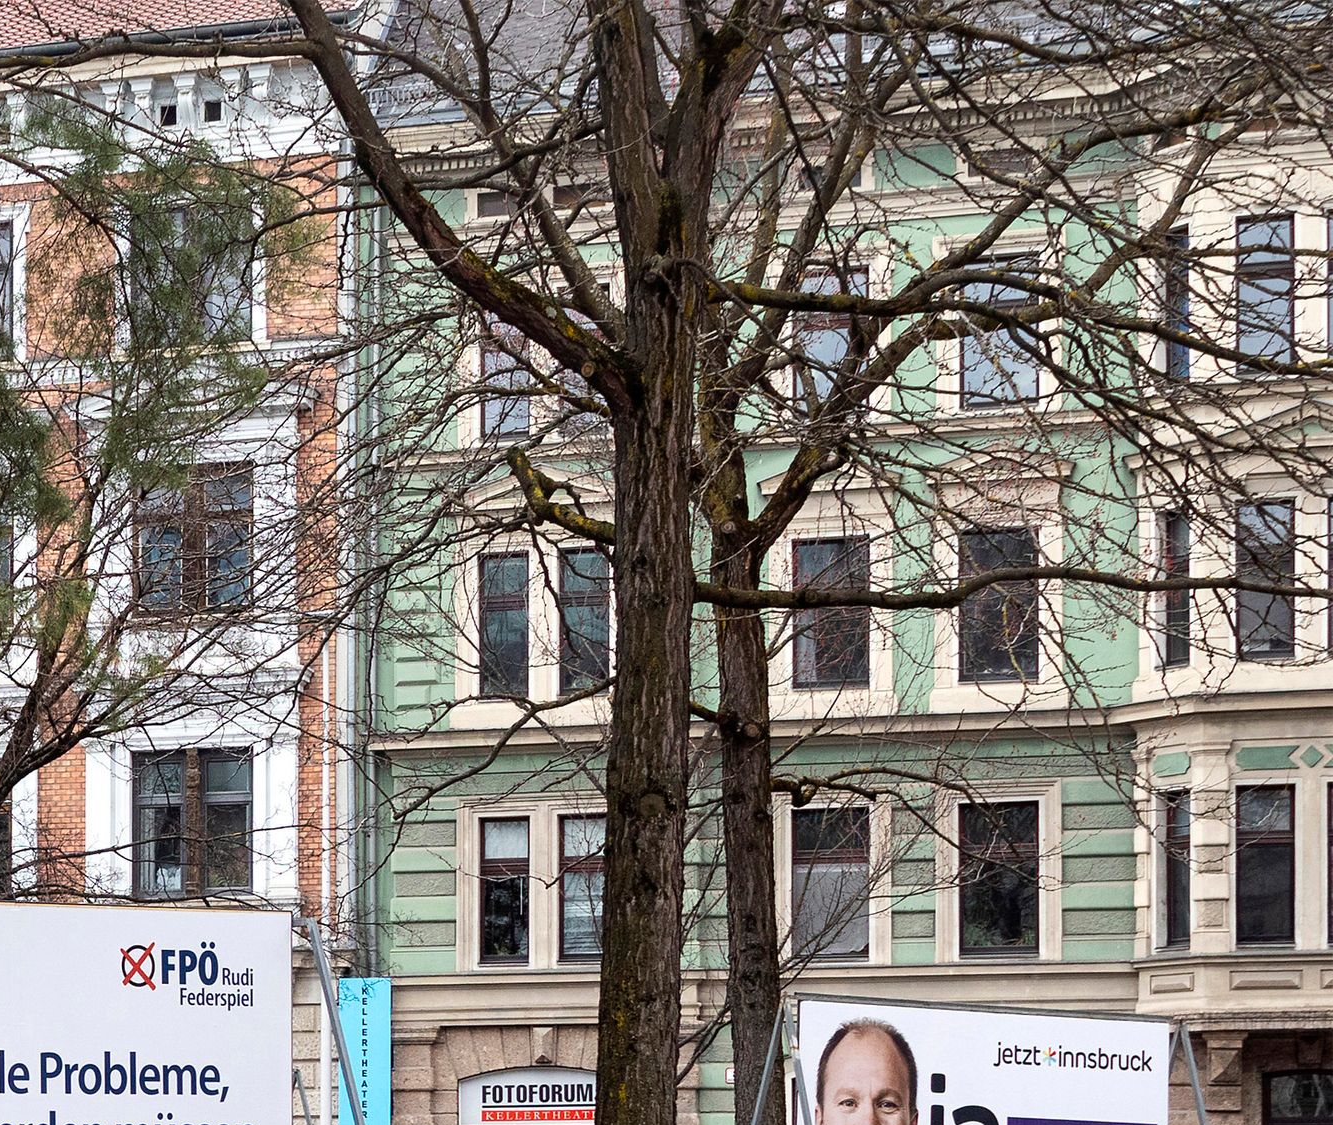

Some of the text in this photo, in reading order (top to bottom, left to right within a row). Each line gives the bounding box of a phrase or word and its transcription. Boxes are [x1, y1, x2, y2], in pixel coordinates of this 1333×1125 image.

[160, 941, 254, 987] FPÖ Rudi
[179, 987, 254, 1011] Federspiel
[361, 987, 369, 1119] KELLERTHEATER
[993, 1041, 1153, 1072] jetzt innsbruck
[40, 1051, 230, 1103] Probleme,
[481, 1083, 594, 1104] FOTOFORUM
